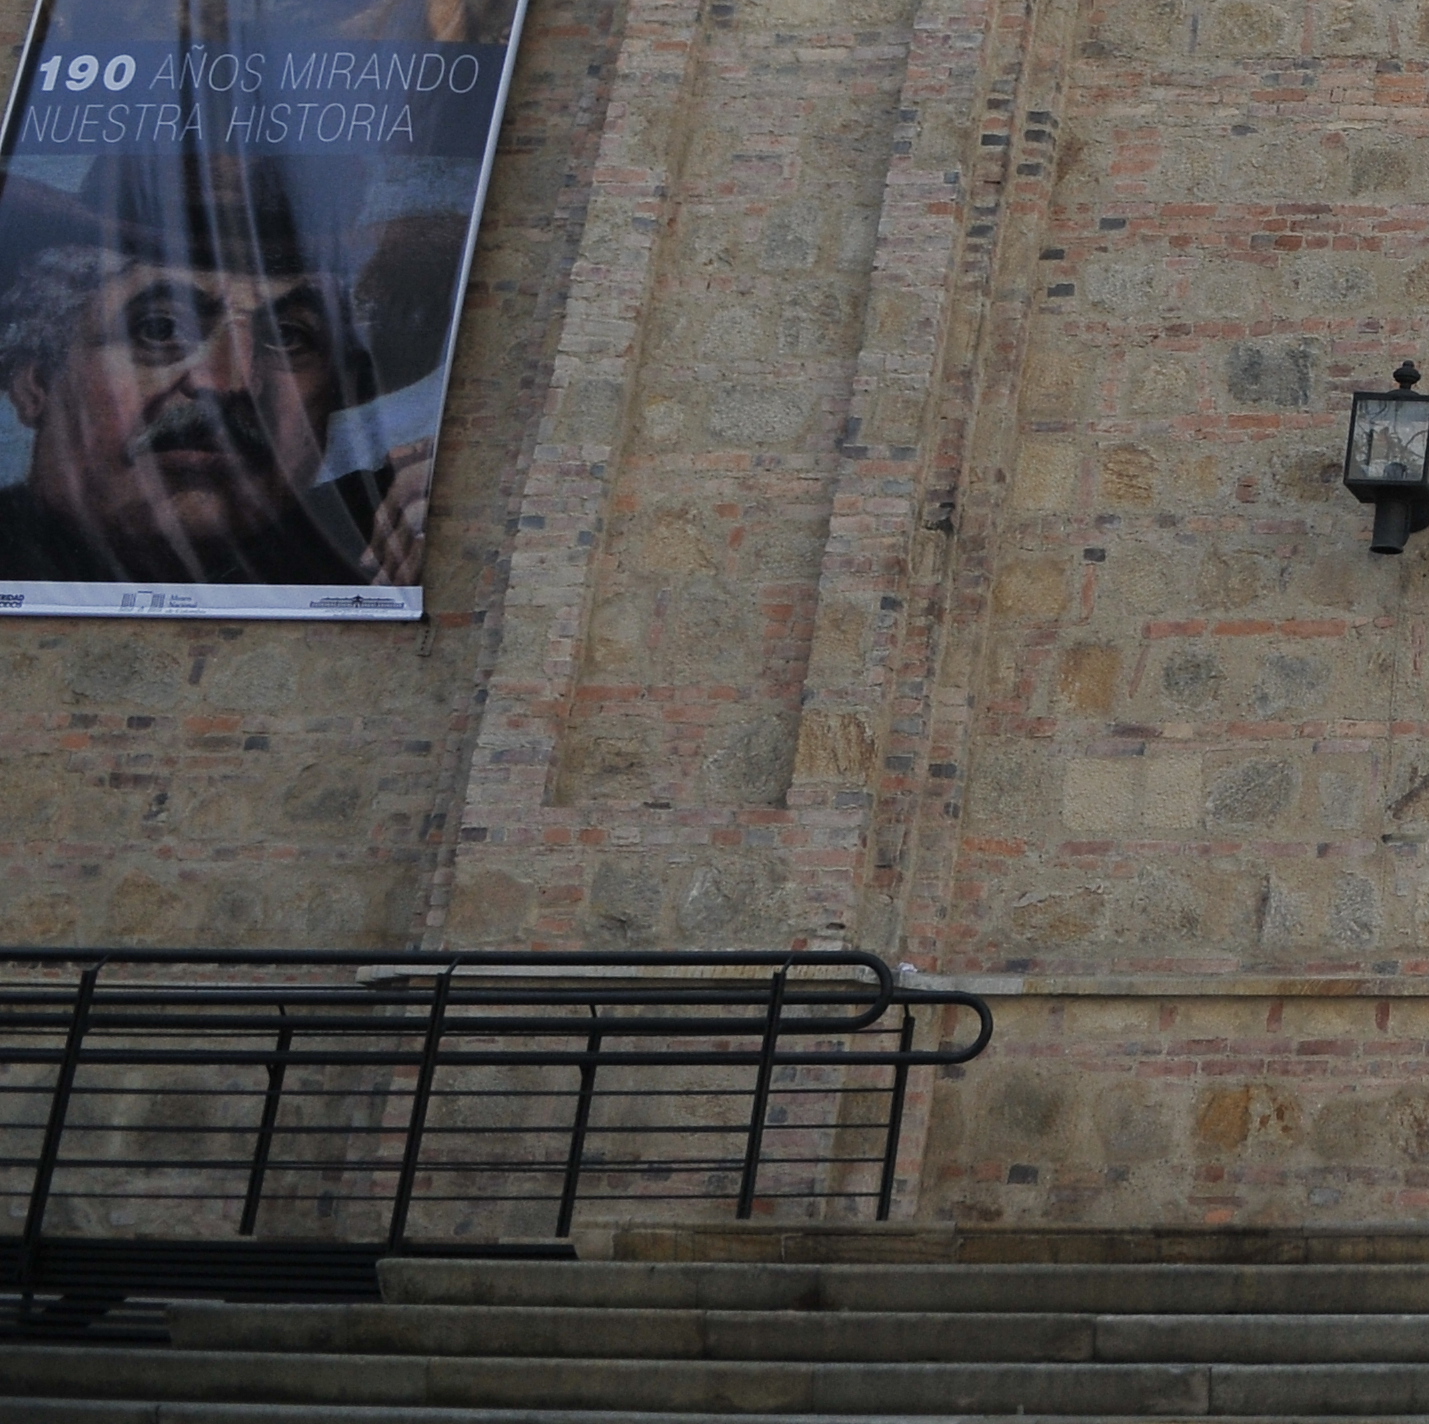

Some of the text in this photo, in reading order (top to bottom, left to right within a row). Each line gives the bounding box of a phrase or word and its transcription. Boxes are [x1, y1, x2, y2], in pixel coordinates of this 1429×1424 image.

[40, 44, 480, 94] 190 AÑOS MIRANDO
[21, 103, 414, 143] NUESTRA HISTORIA
